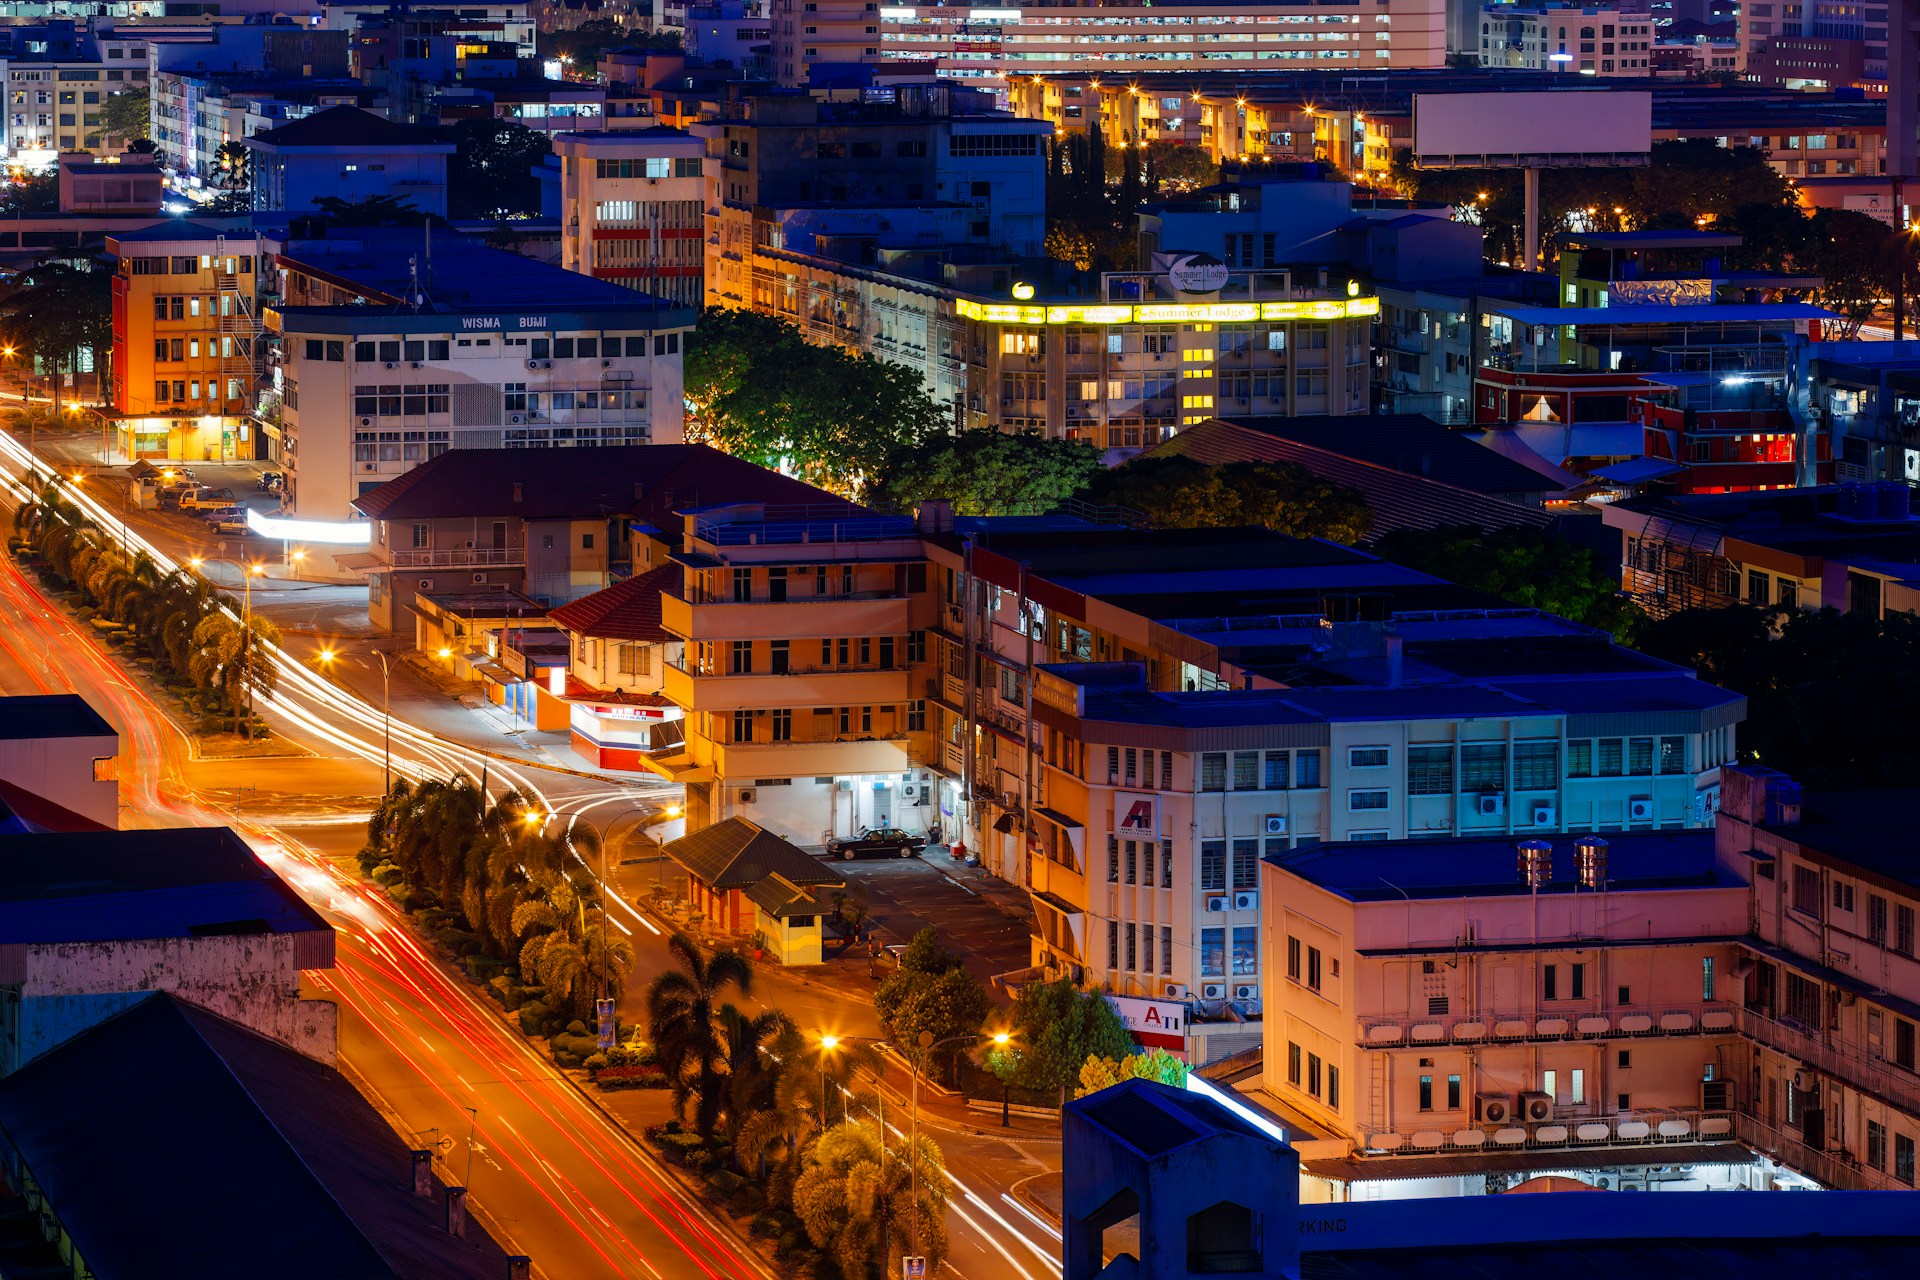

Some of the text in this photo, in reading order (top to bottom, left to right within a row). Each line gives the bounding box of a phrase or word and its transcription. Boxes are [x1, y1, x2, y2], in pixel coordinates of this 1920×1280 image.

[1175, 269, 1226, 280] Summer Lodge
[1149, 307, 1245, 319] Summer Lodge
[462, 317, 546, 329] WISMA BUMI
[1144, 1006, 1179, 1030] ATI
